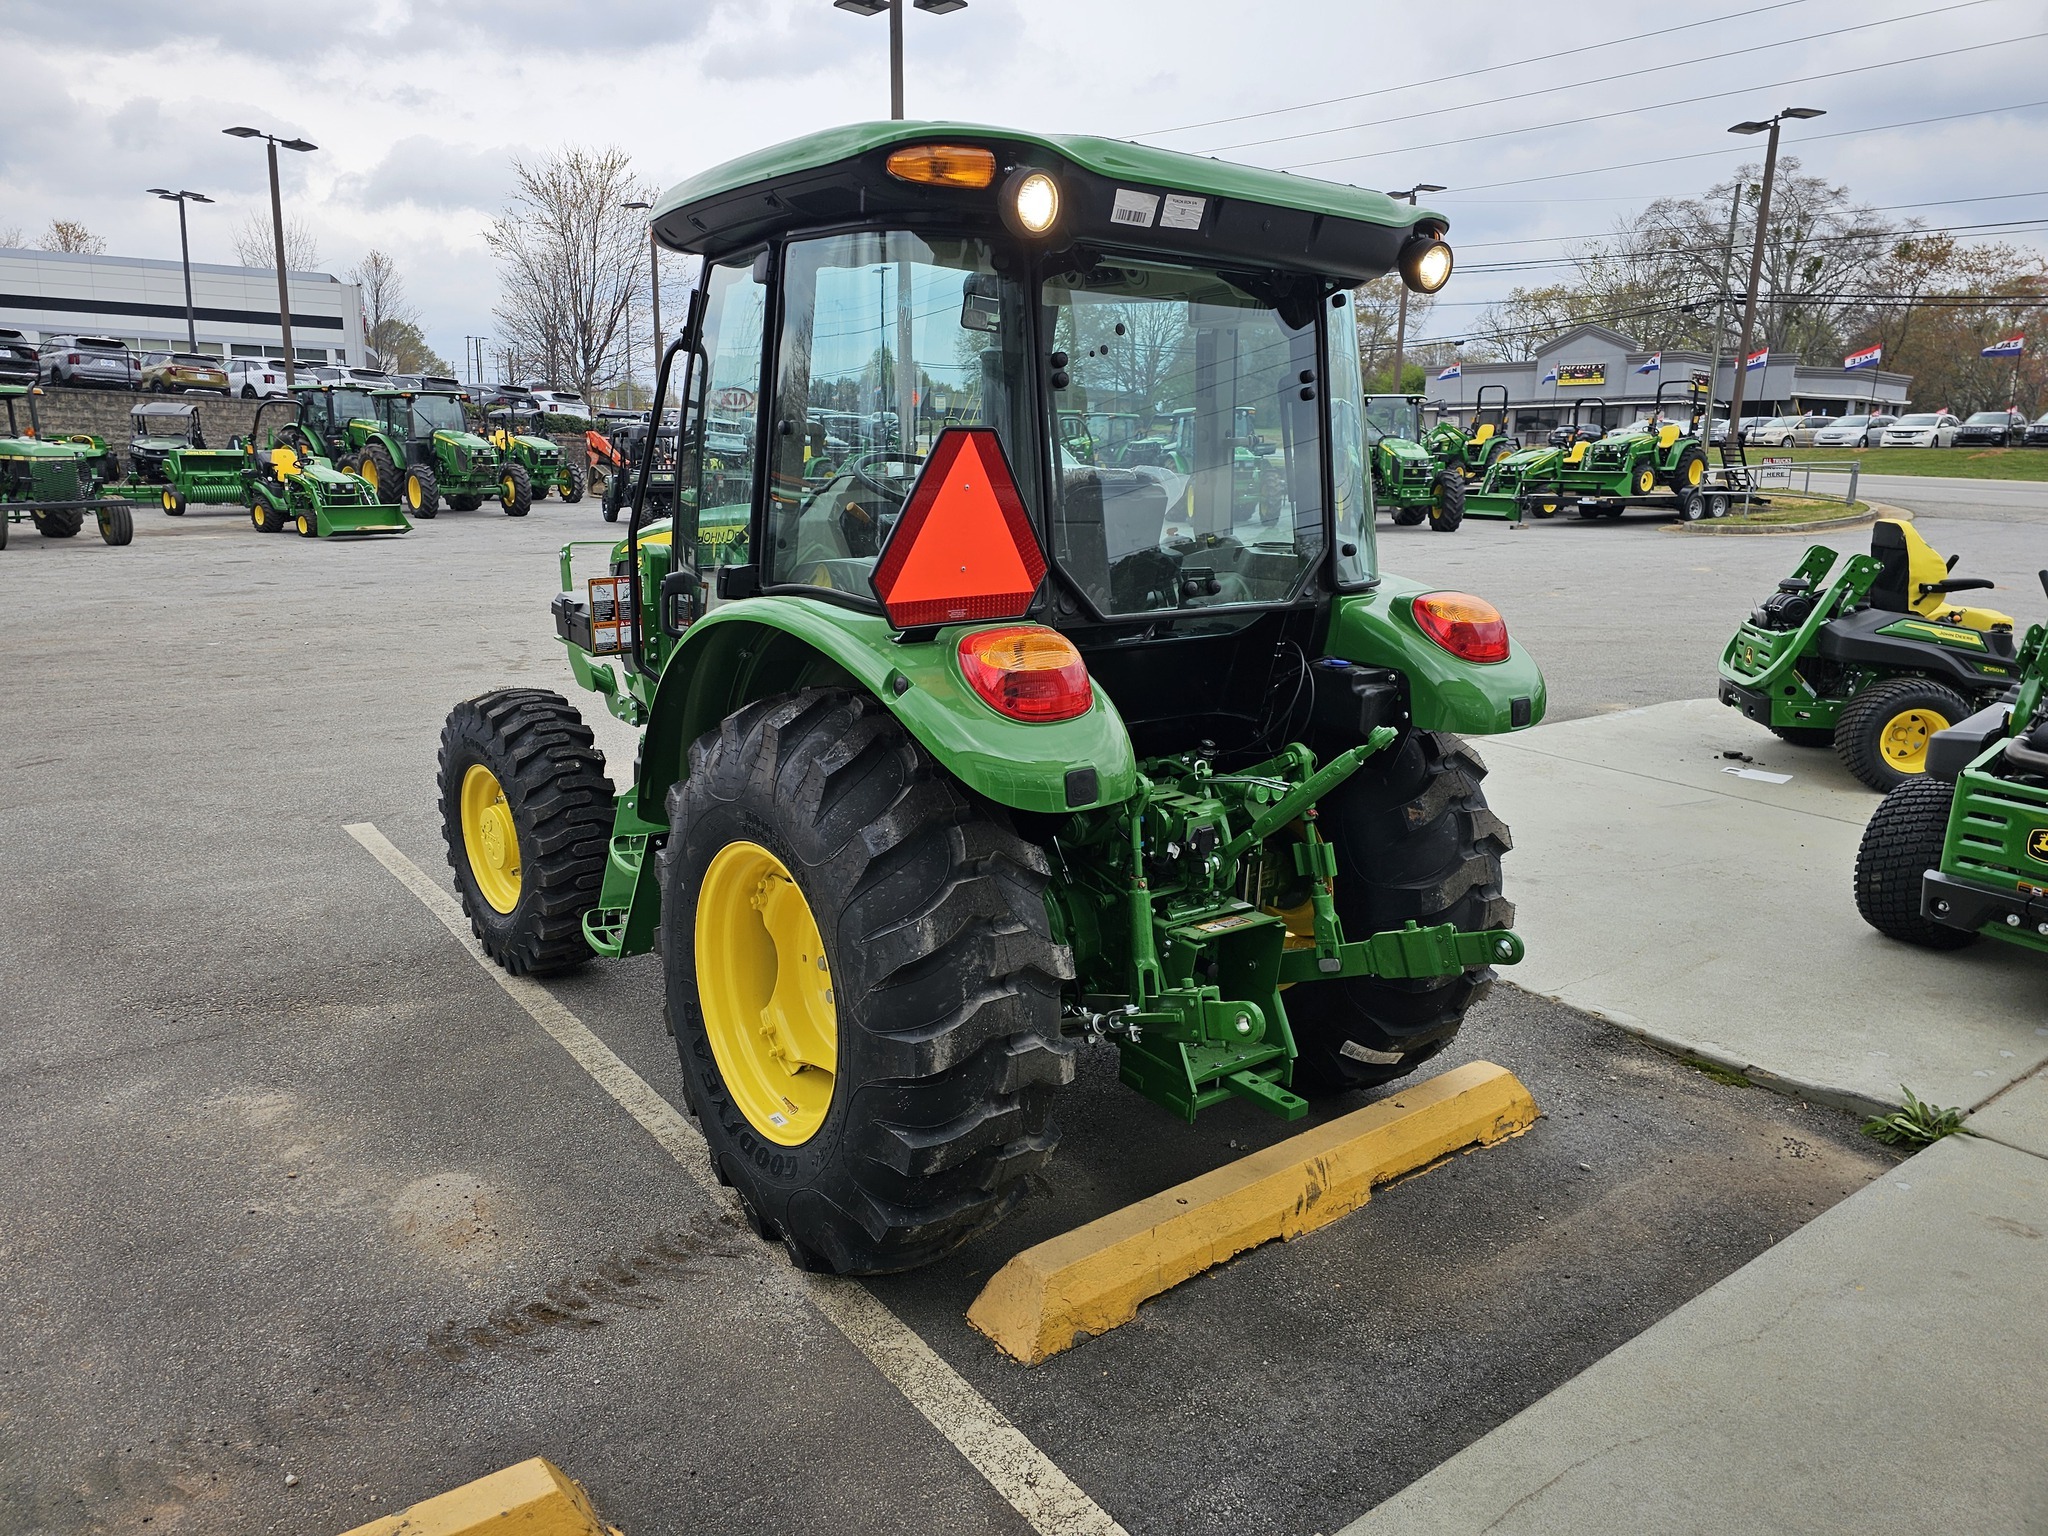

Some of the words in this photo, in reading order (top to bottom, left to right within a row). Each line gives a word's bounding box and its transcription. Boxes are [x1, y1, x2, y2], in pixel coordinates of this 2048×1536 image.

[722, 393, 748, 405] KIA
[698, 530, 726, 543] JOHN
[1955, 633, 1974, 641] DEERE
[683, 1001, 798, 1180] GOODYEAR
